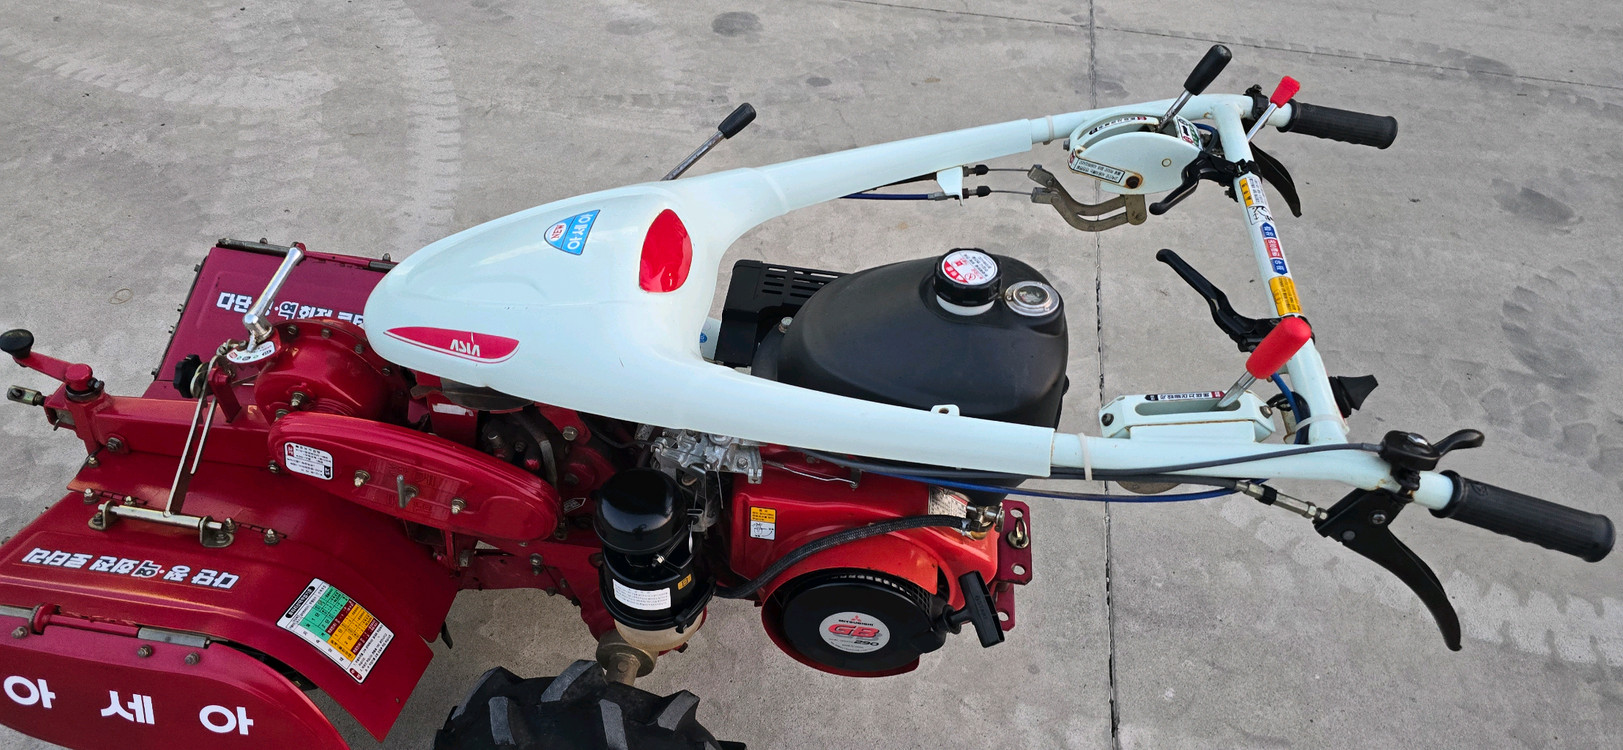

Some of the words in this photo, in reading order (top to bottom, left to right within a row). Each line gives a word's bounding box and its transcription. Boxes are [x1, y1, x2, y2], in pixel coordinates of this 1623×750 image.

[550, 224, 565, 239] NEW
[217, 291, 253, 313] 다단
[449, 338, 481, 358] ASIA
[22, 547, 94, 570] 로타리
[191, 568, 240, 589] 다단
[828, 624, 880, 639] GB
